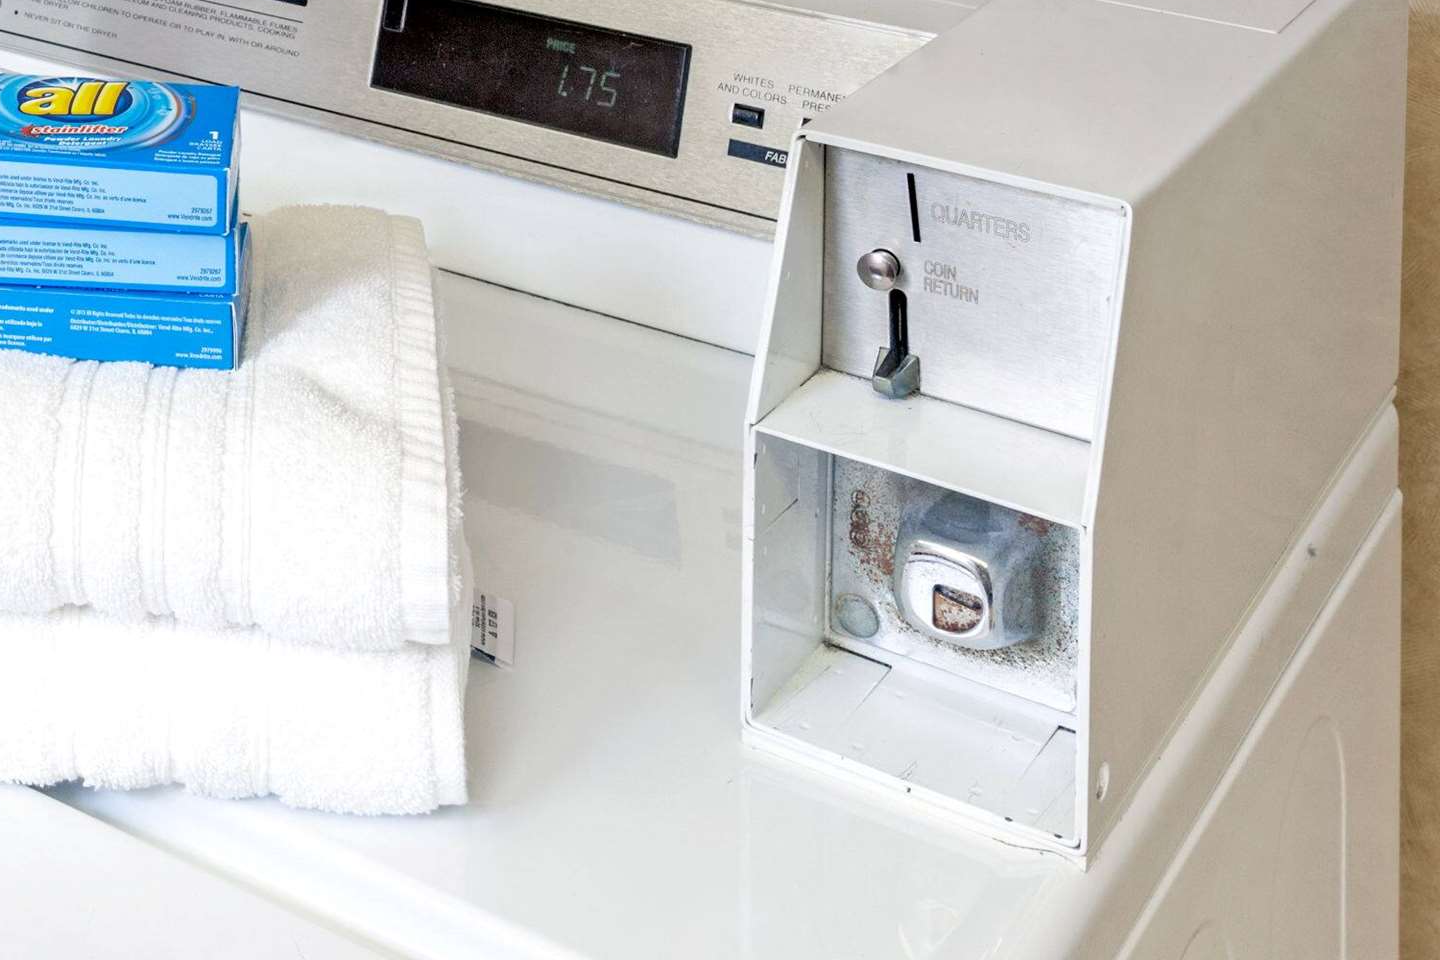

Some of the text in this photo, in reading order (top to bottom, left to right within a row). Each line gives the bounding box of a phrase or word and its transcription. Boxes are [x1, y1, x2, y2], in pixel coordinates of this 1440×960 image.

[558, 64, 620, 107] 1.75
[718, 82, 788, 105] AND COLORS
[733, 72, 774, 89] WHITES
[20, 81, 128, 116] all
[930, 202, 1032, 243] QUARTERS
[924, 260, 957, 280] COIN
[924, 276, 979, 304] RETURN
